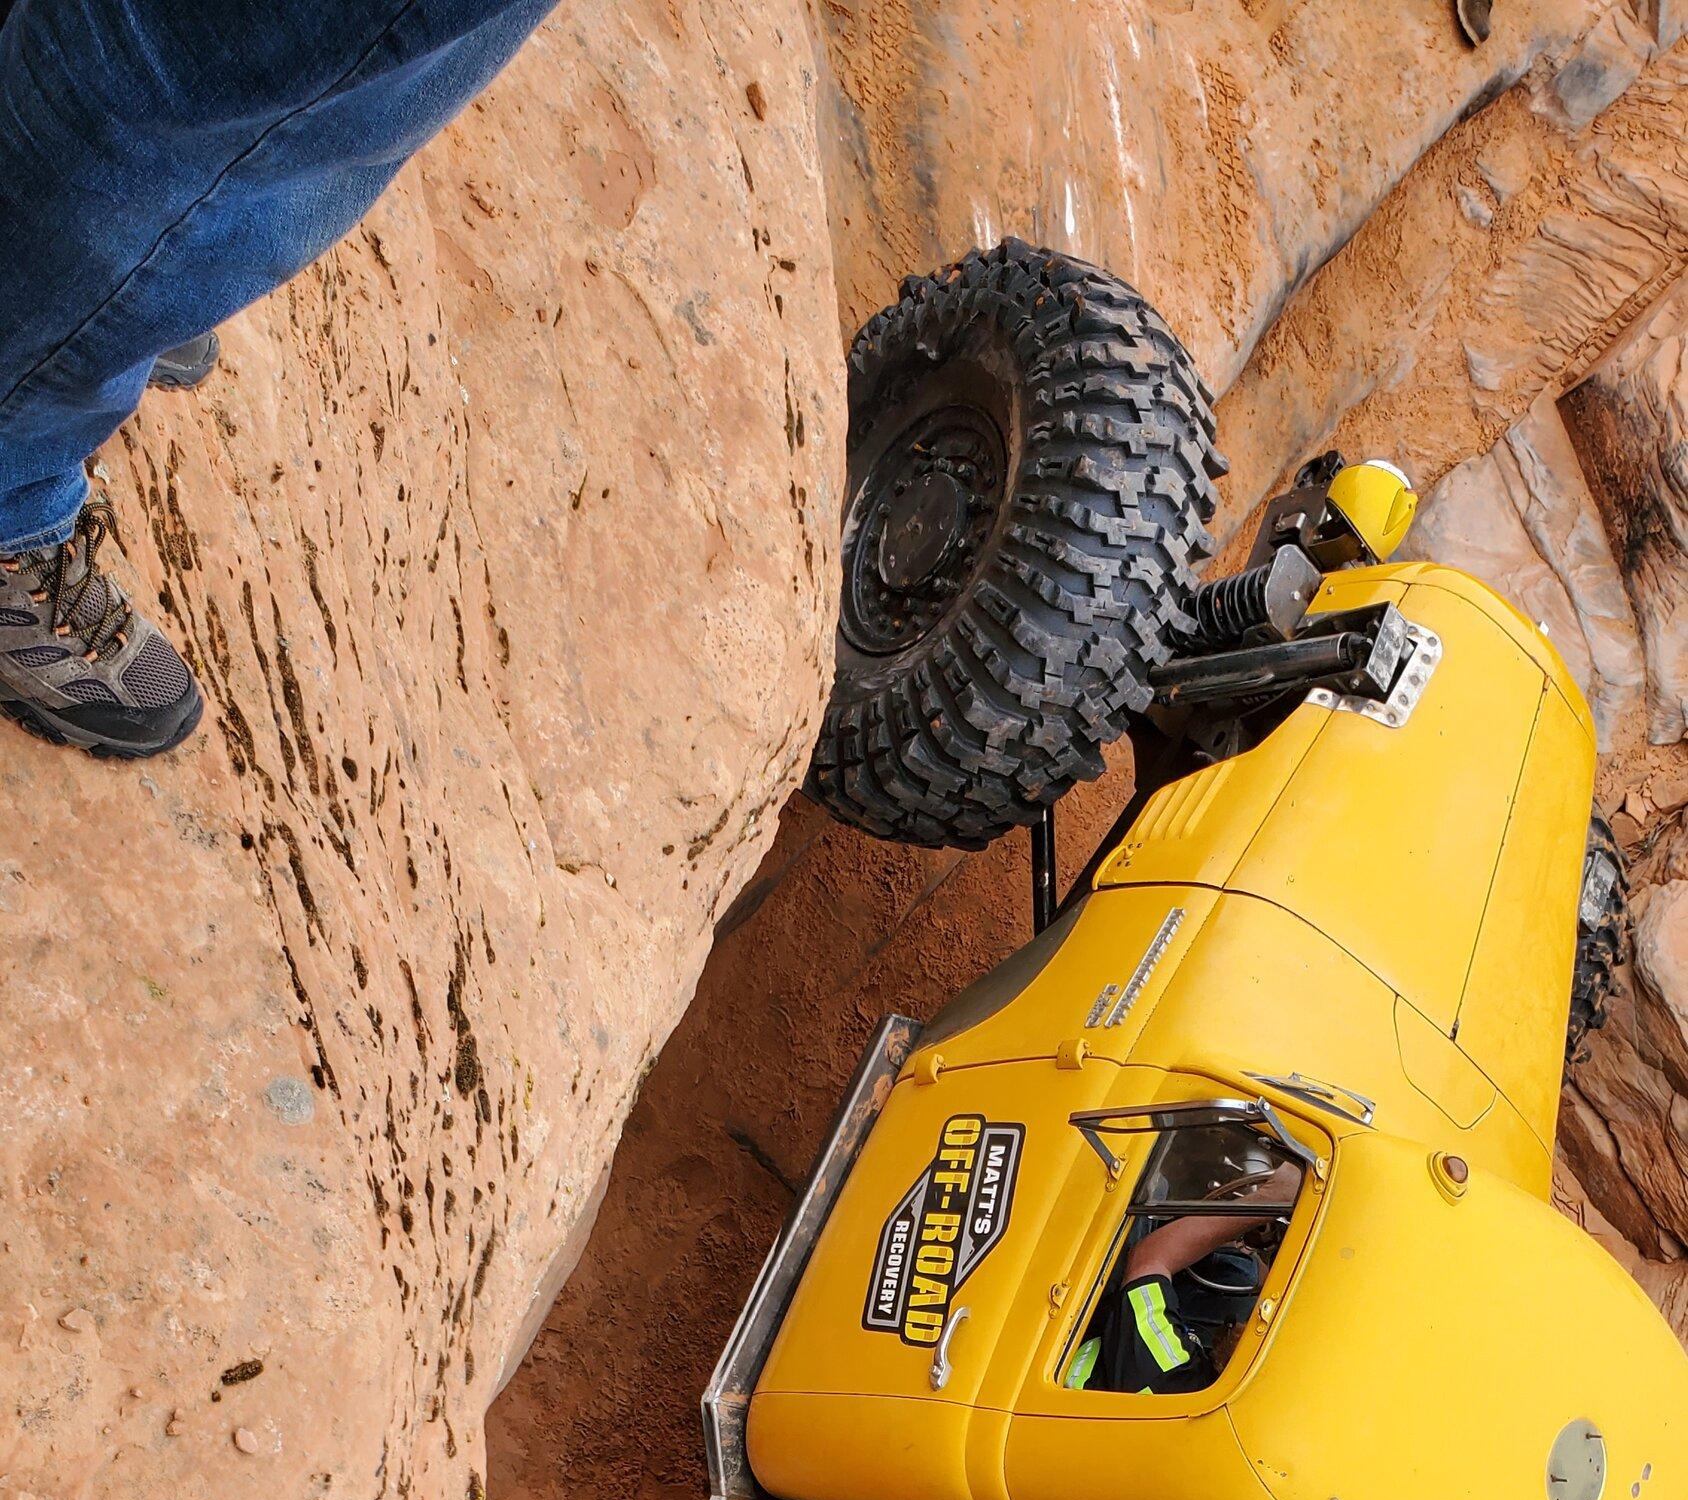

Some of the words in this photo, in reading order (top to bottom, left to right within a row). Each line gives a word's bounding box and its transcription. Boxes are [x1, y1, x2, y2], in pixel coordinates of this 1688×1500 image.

[904, 1118, 982, 1343] OFF-ROAD
[974, 1145, 1006, 1235] MATT'S
[877, 1220, 910, 1315] RECOVERY
